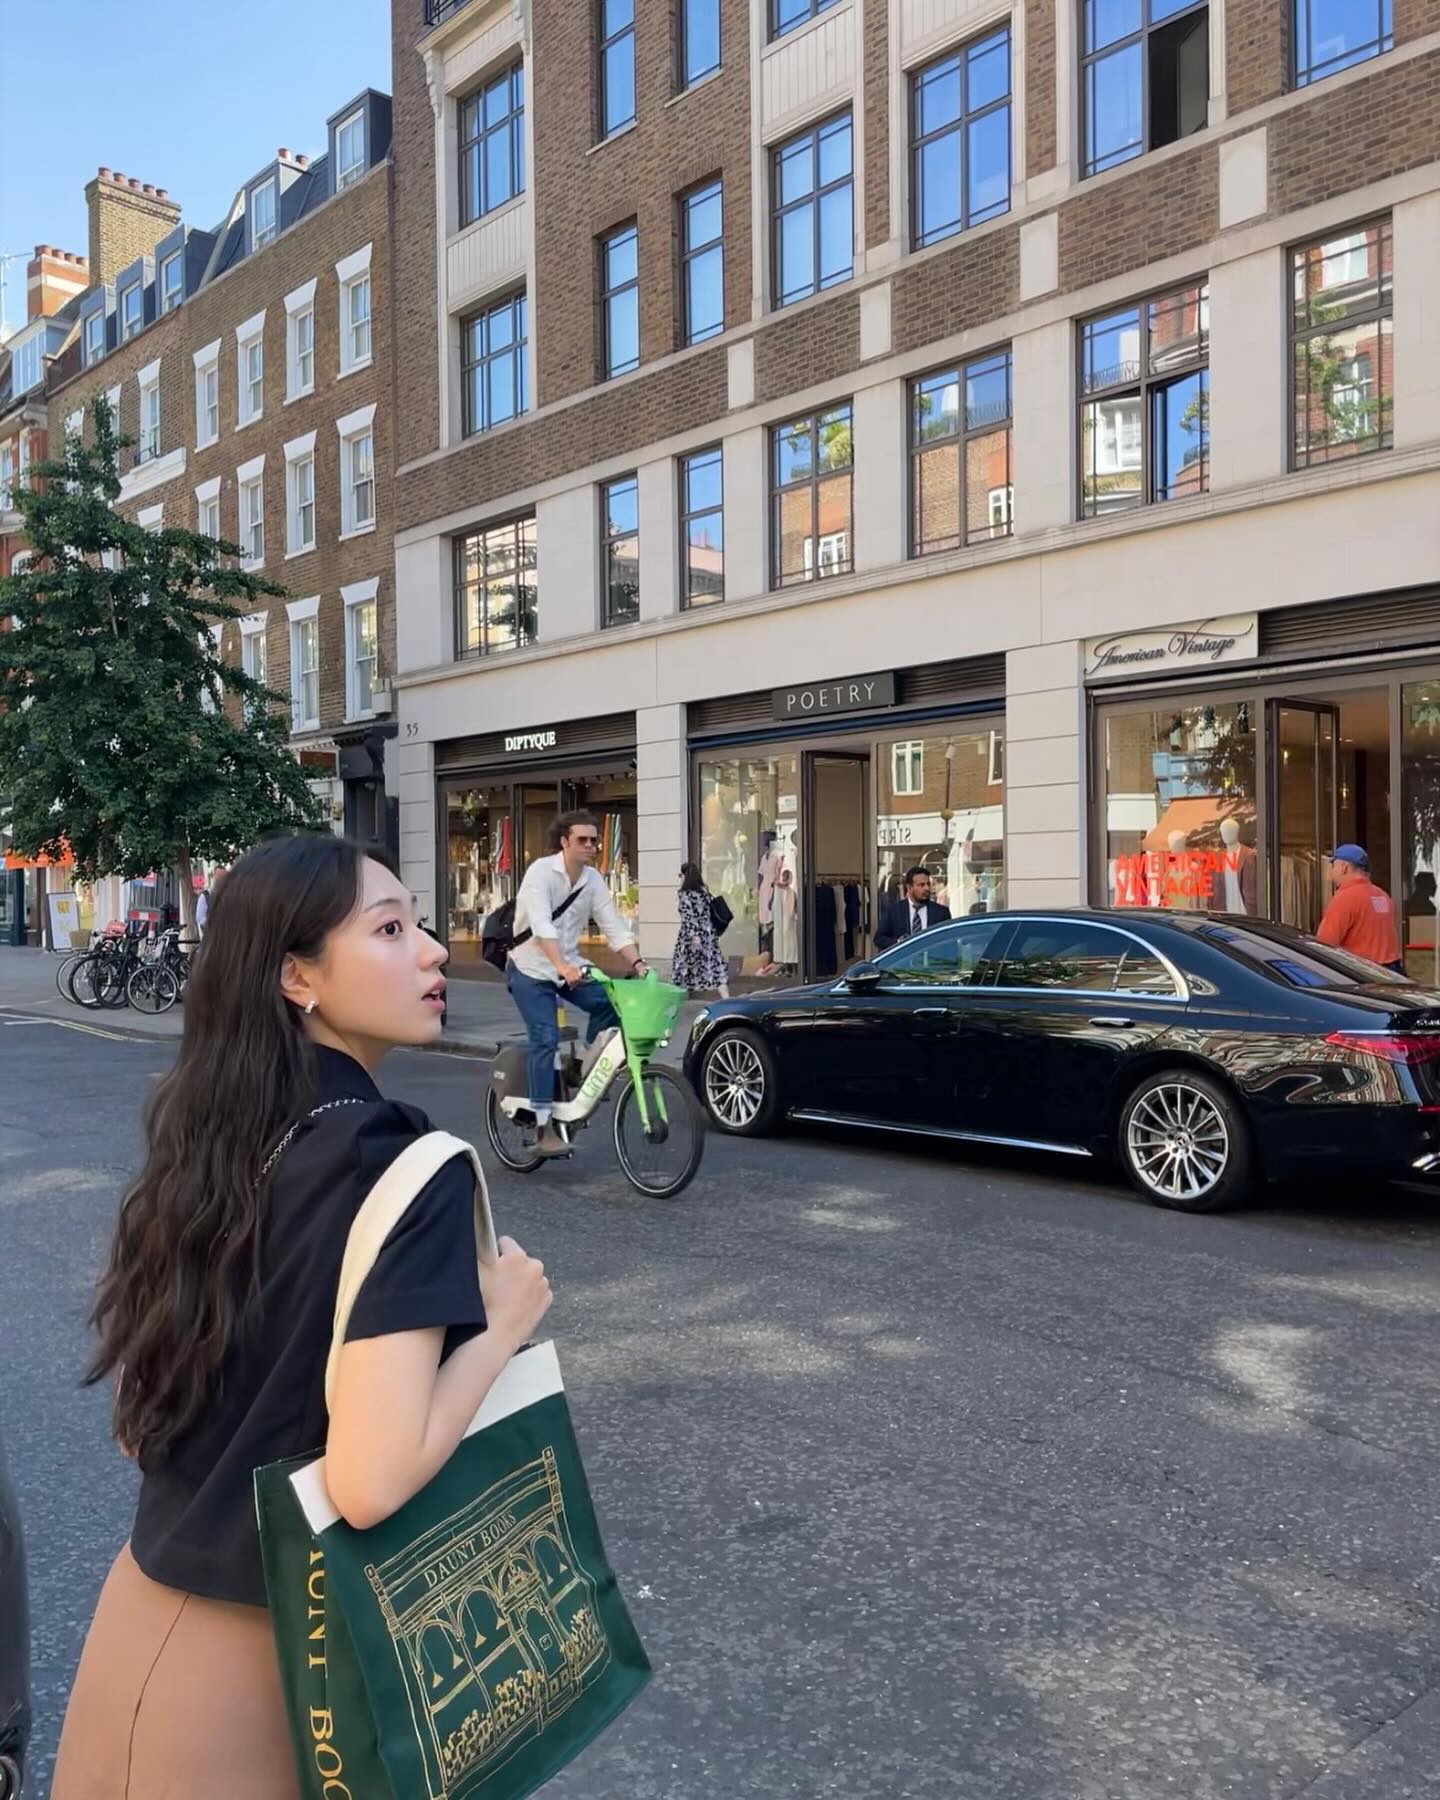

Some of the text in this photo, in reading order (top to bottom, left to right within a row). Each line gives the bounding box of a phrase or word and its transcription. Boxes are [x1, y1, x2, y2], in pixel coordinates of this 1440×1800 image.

[1086, 619, 1236, 674] American Vintage
[786, 682, 876, 712] POETRY
[504, 731, 556, 751] DIPTYQUE
[1115, 850, 1240, 873] AMERICAN
[1115, 873, 1214, 898] VINTAGE
[423, 1509, 517, 1589] DAUNT BOOKS
[307, 1551, 328, 1679] UNT
